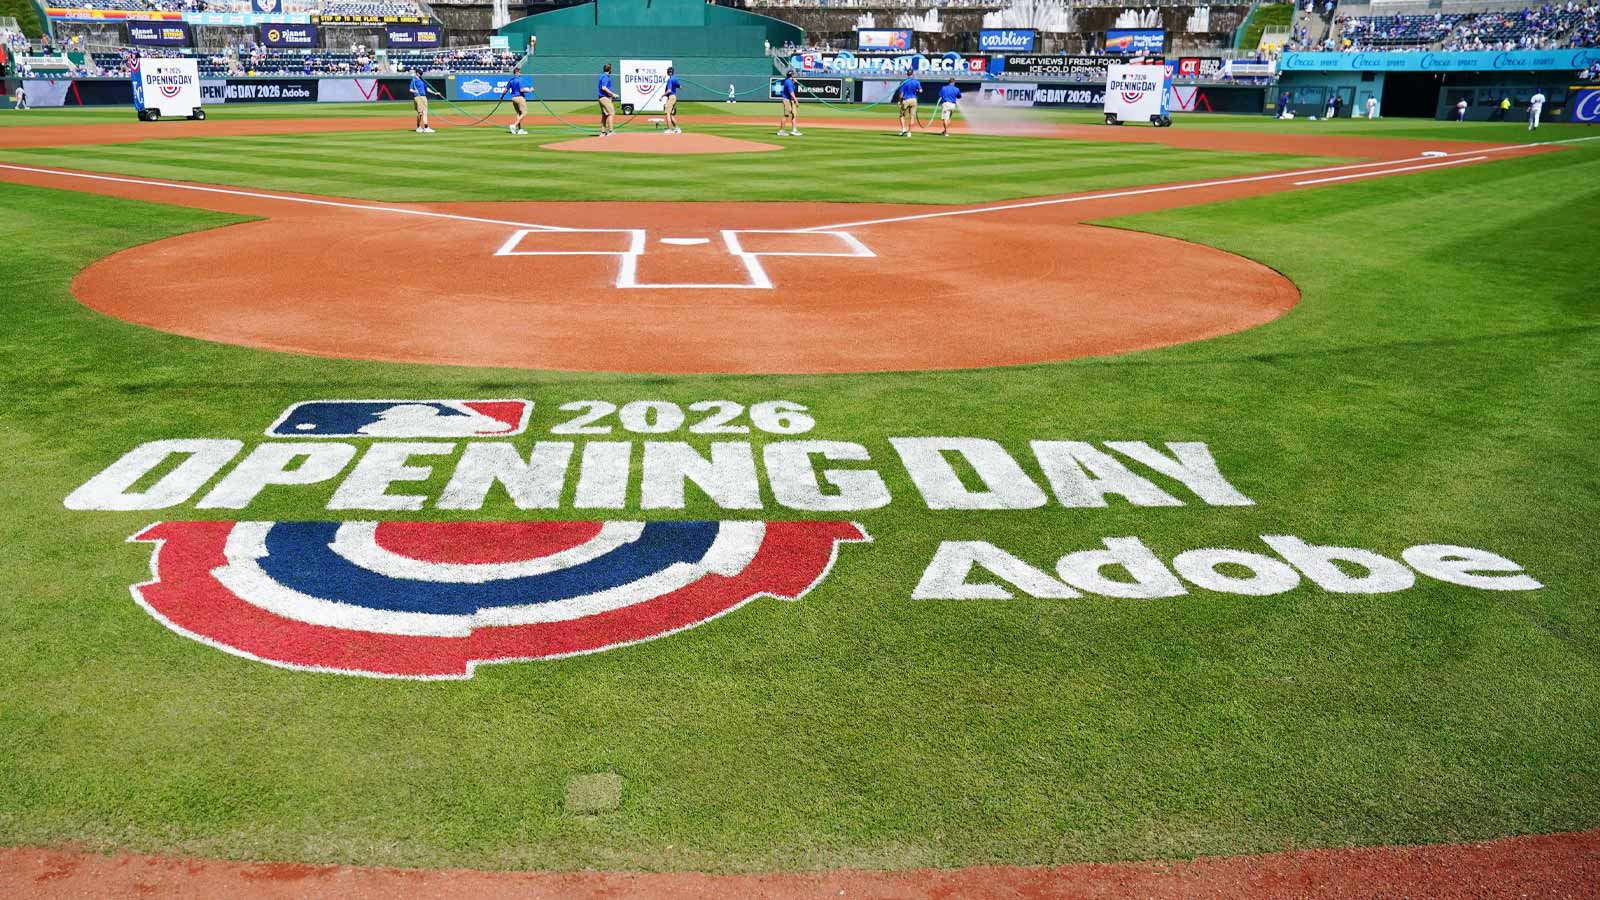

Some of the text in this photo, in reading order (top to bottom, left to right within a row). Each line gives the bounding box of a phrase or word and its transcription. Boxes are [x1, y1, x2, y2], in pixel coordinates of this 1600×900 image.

[282, 29, 306, 37] planet
[286, 35, 311, 43] fitness
[982, 31, 1031, 46] carbliss
[822, 57, 968, 71] FOUNTAIN DECK
[970, 59, 984, 71] QT
[1182, 61, 1196, 73] QT
[1286, 52, 1314, 68] Circa
[1352, 52, 1380, 68] Circa
[1421, 53, 1450, 69] Circa
[1493, 52, 1525, 68] Circa
[146, 75, 192, 85] OPENING DAY
[625, 75, 667, 84] OPENING DAY
[1110, 81, 1156, 92] OPENING DAY
[200, 86, 310, 98] PENING DAY 2026 Adobe
[798, 85, 840, 95] Kansas City
[1006, 89, 1048, 102] OPENING
[1048, 89, 1067, 103] DAY
[1068, 90, 1091, 103] 2026
[549, 399, 816, 435] 2026
[63, 436, 1255, 511] OPENING DAY
[911, 534, 1544, 599] Adobe
